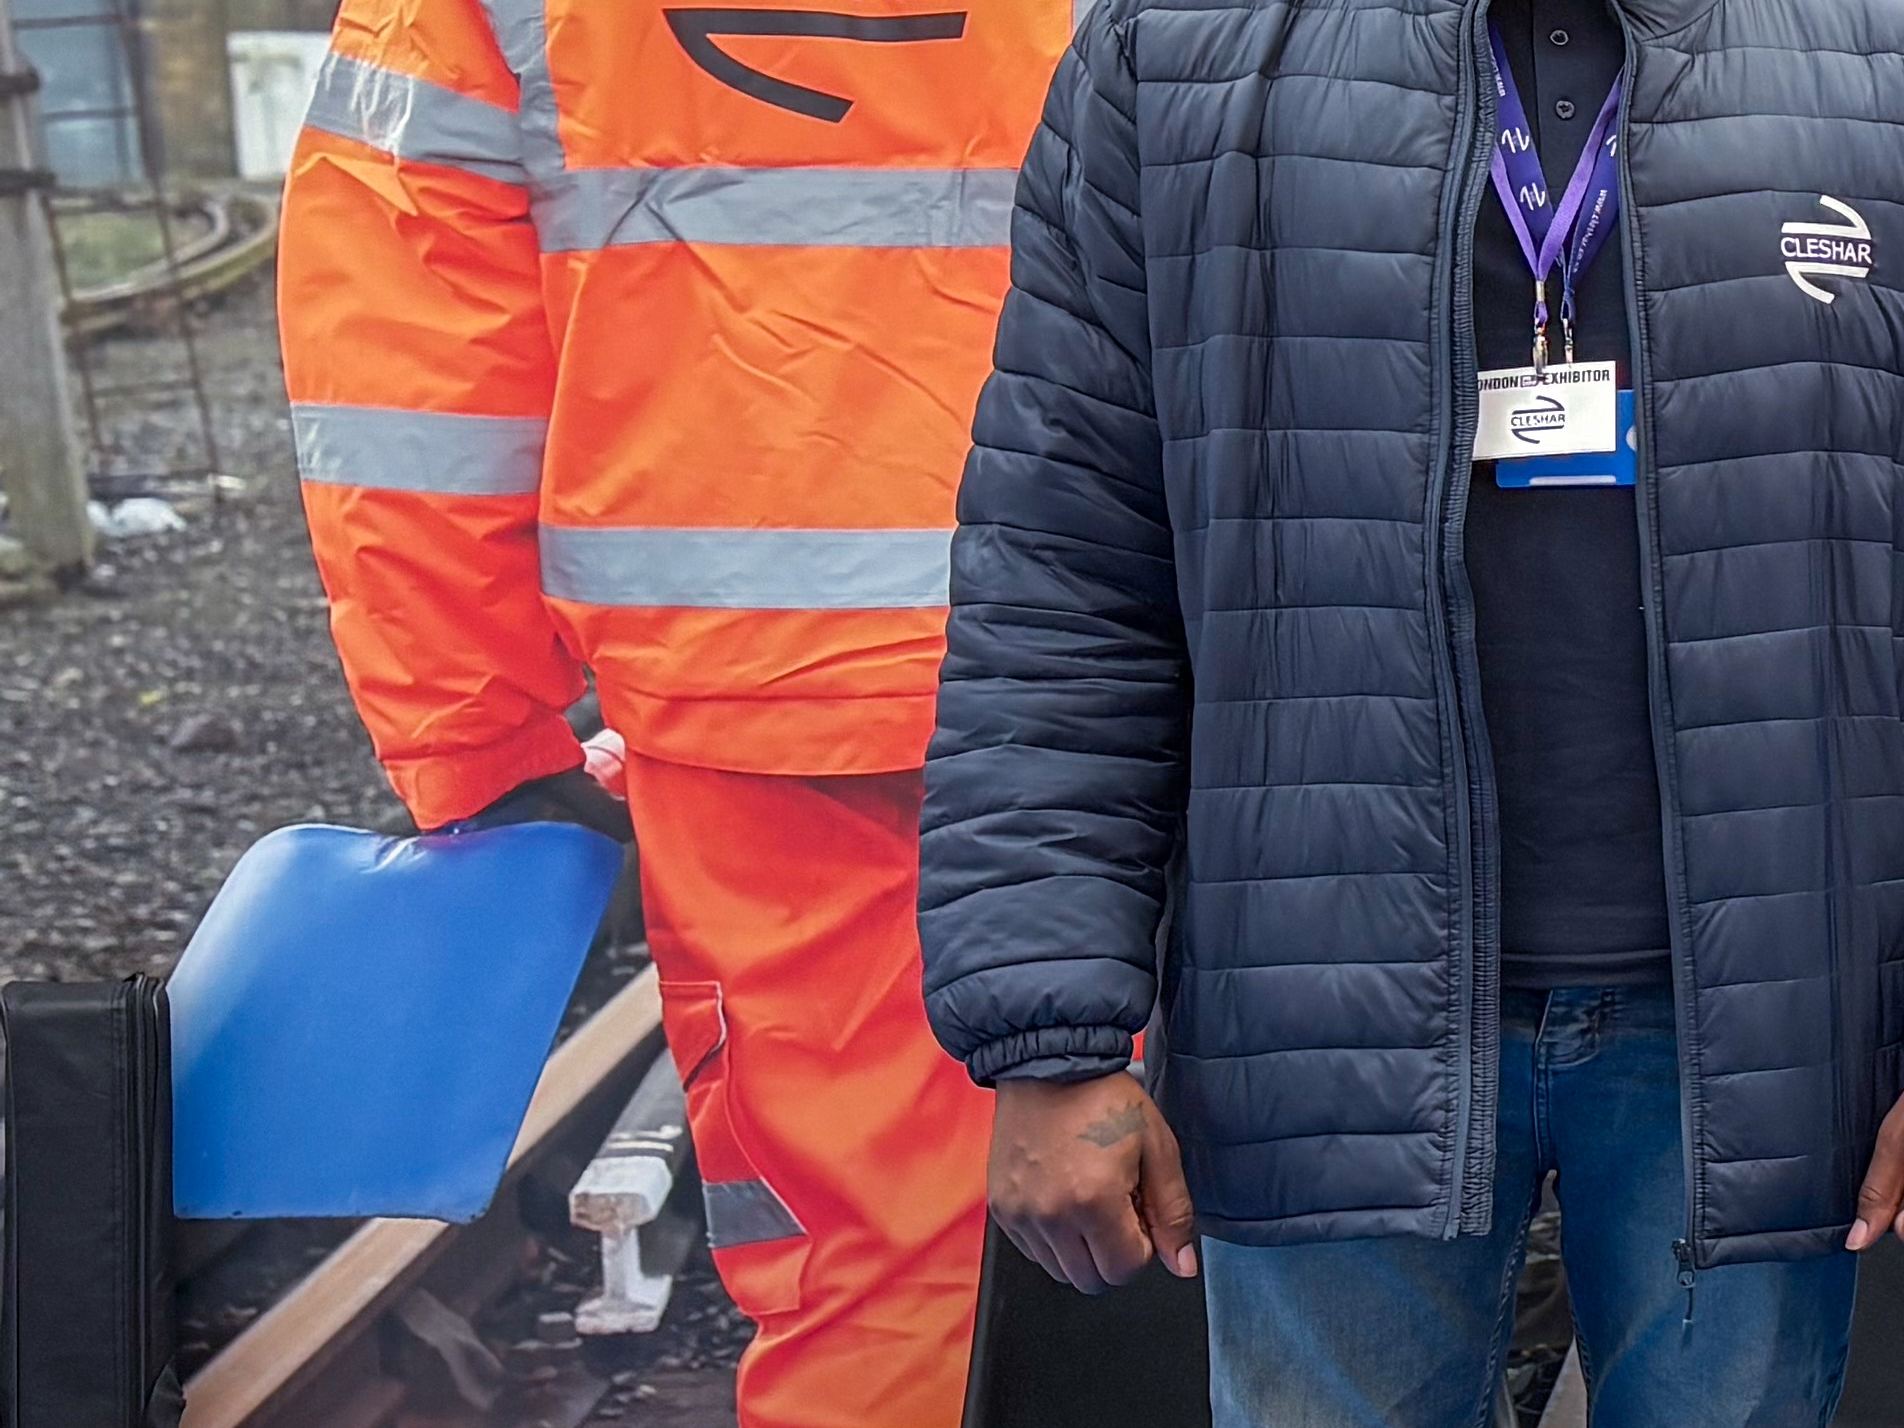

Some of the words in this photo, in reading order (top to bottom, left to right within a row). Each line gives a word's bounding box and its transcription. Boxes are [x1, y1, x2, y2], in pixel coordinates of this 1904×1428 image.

[1781, 236, 1872, 265] CLESHAR
[1542, 369, 1610, 384] EXHIBITOR
[1511, 412, 1566, 428] CLESHAR
